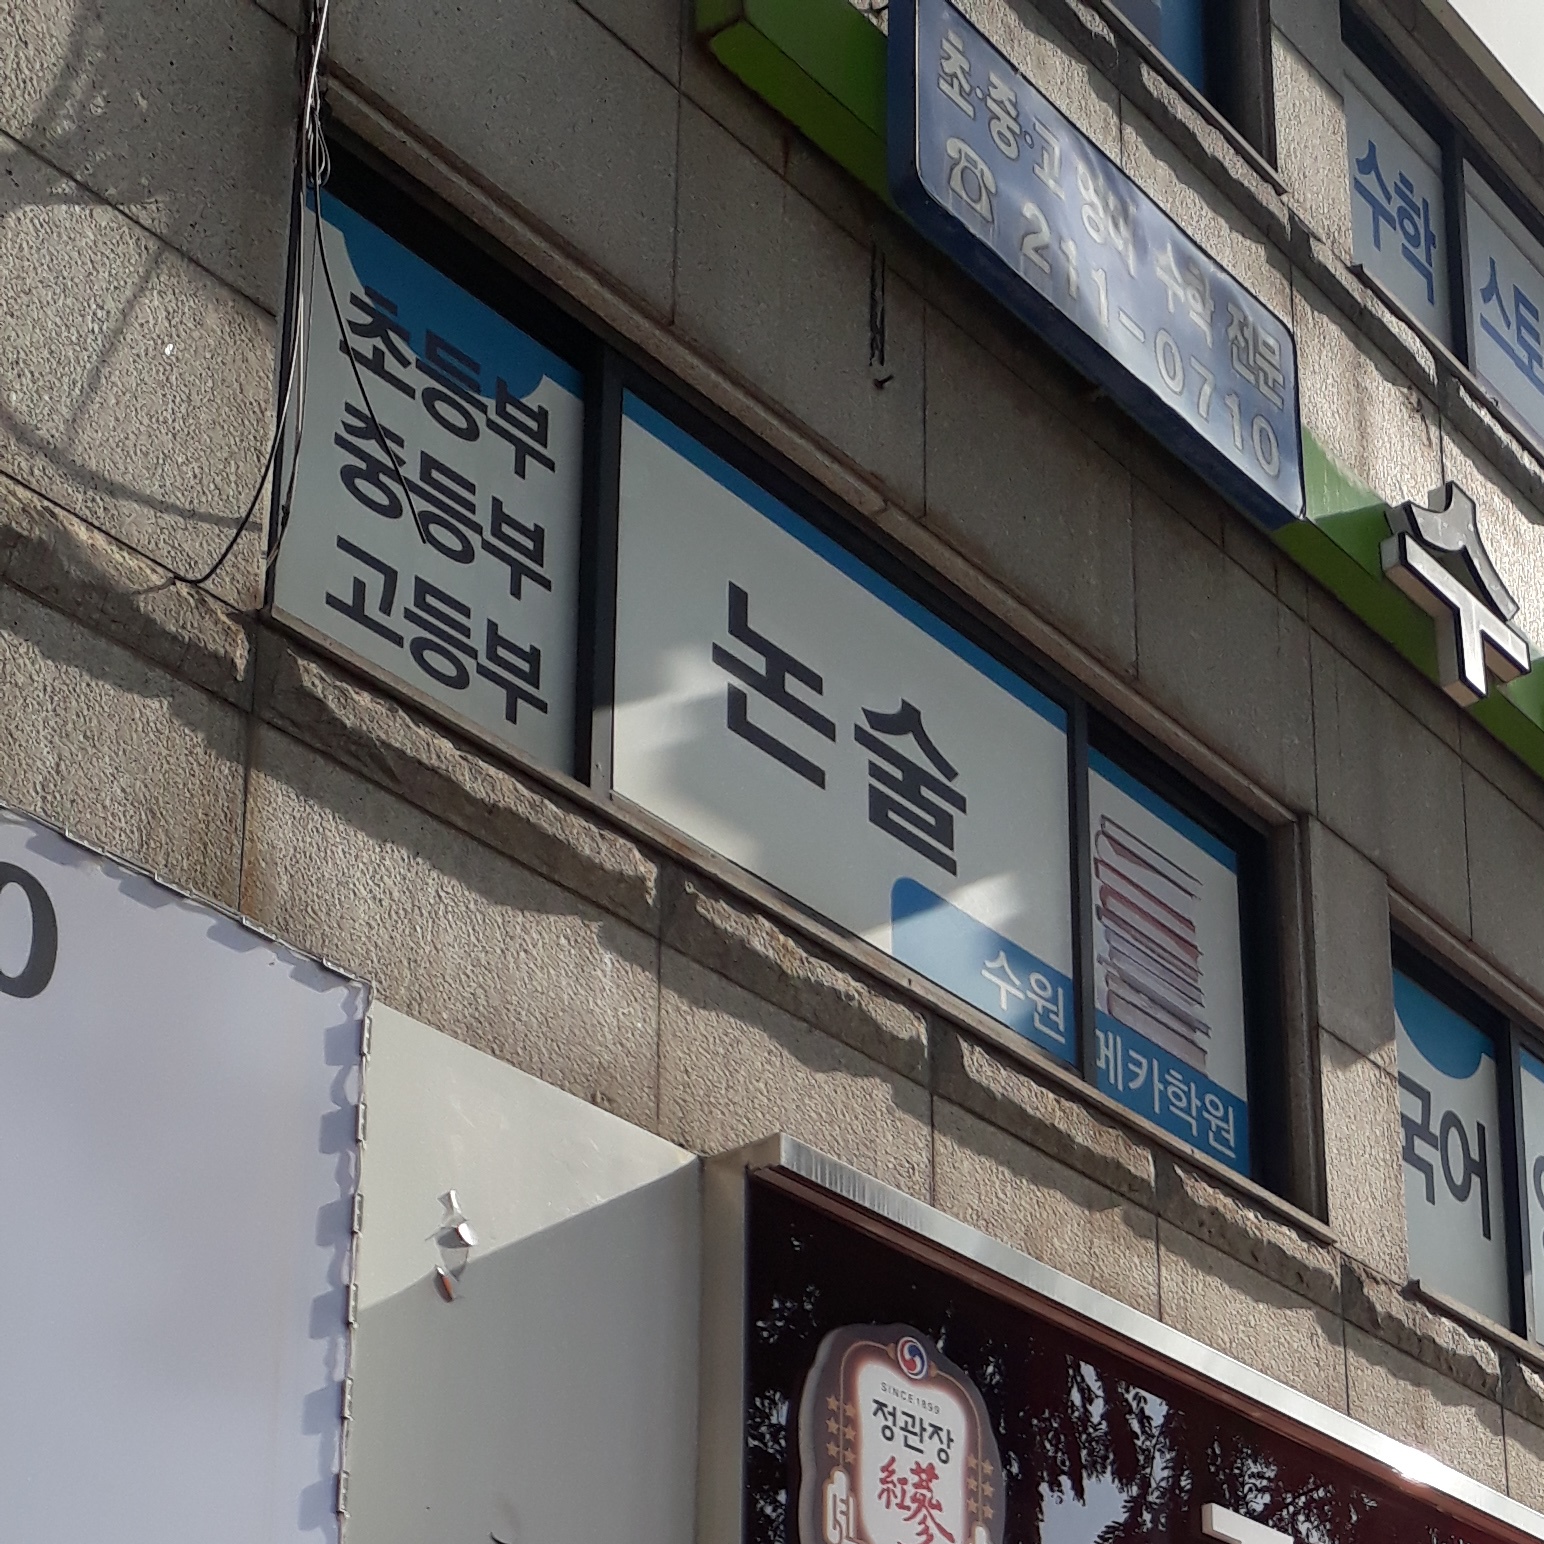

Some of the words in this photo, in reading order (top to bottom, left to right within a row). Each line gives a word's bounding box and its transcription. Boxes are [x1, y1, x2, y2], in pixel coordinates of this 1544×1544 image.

[1353, 139, 1437, 305] 수학
[338, 284, 556, 479] 초등부
[1019, 202, 1281, 478] 211-0710
[1227, 302, 1285, 410] 전문
[333, 400, 553, 600] 중등부
[325, 534, 548, 724] 고등부
[712, 581, 967, 877] 논술
[980, 948, 1066, 1044] 수원
[1400, 1072, 1492, 1240] 국어
[871, 1398, 955, 1465] 정관장
[880, 1381, 915, 1404] SINCE
